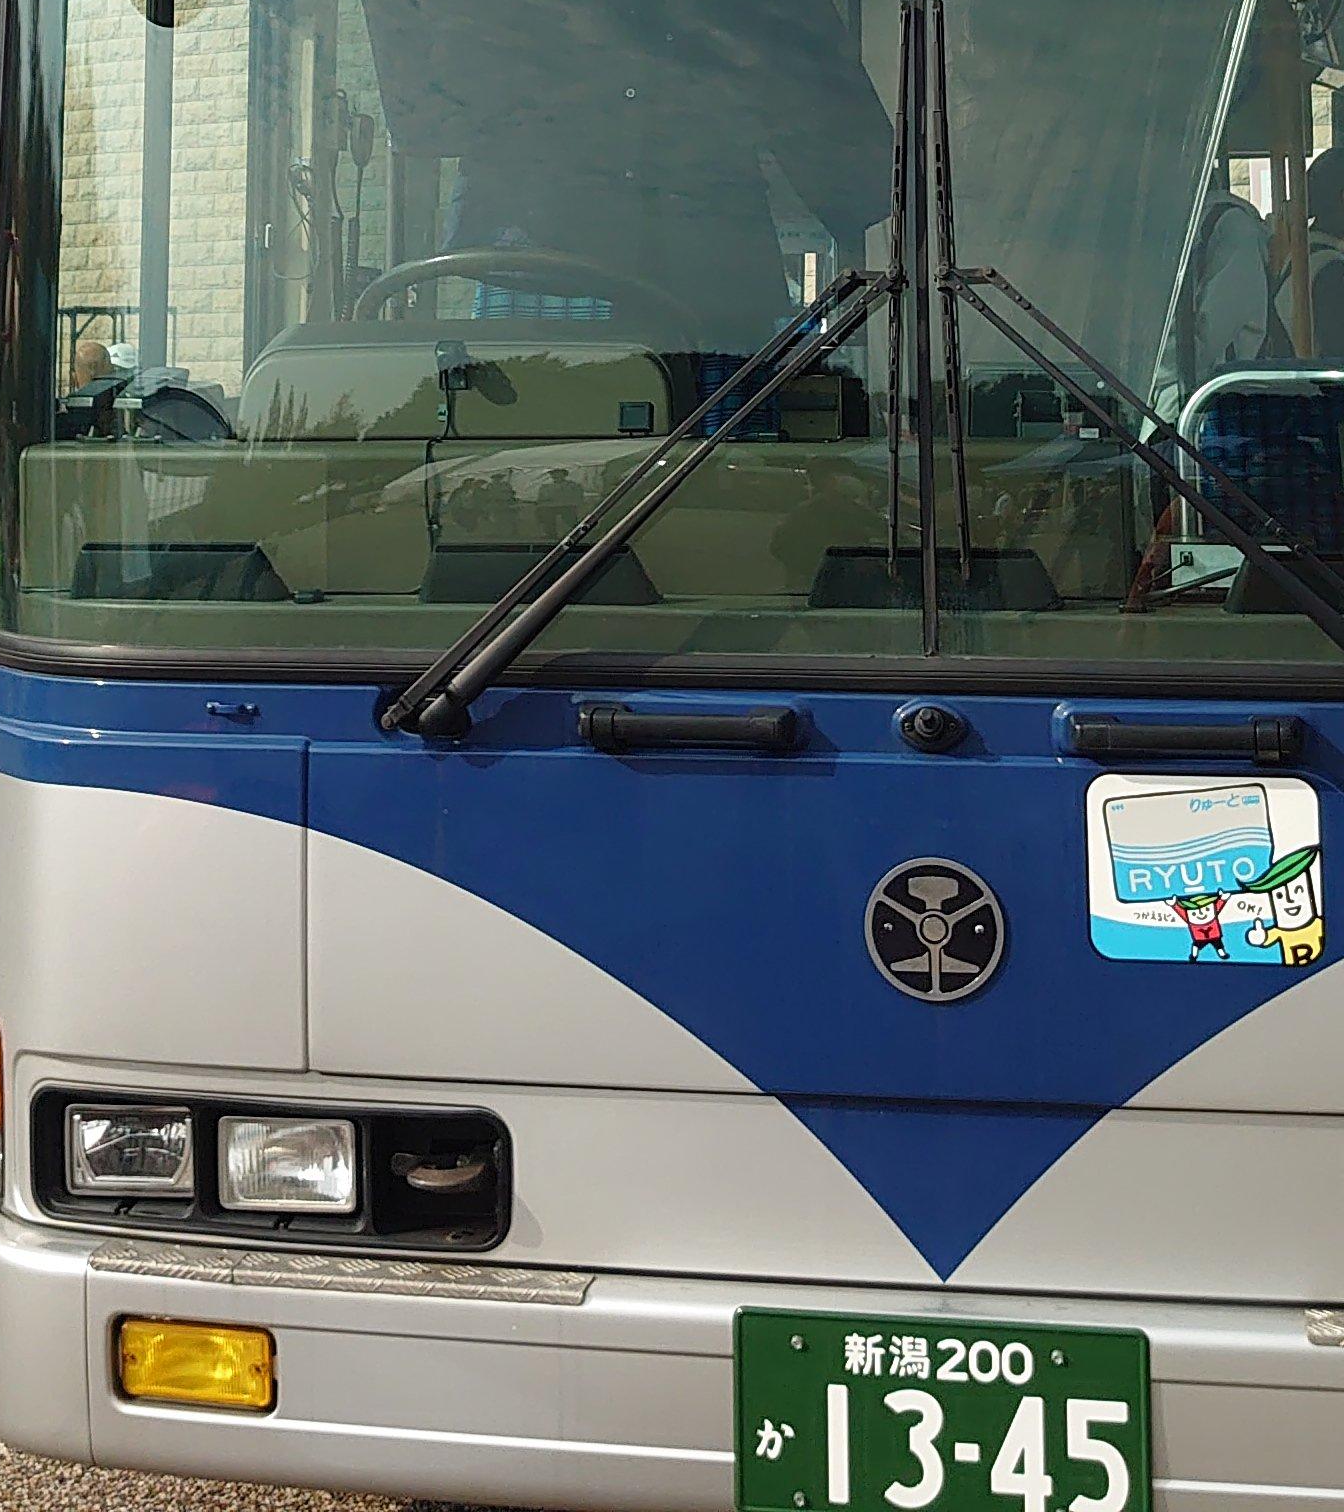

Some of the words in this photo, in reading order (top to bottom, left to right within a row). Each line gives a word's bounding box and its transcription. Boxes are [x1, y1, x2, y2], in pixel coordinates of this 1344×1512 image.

[1189, 793, 1240, 813] りゅーと
[1128, 857, 1255, 893] RYUTO
[1237, 900, 1262, 915] OK!
[1290, 943, 1313, 966] B
[844, 1333, 1034, 1385] 新潟200
[755, 1418, 796, 1461] か
[827, 1383, 1130, 1512] 13-45
